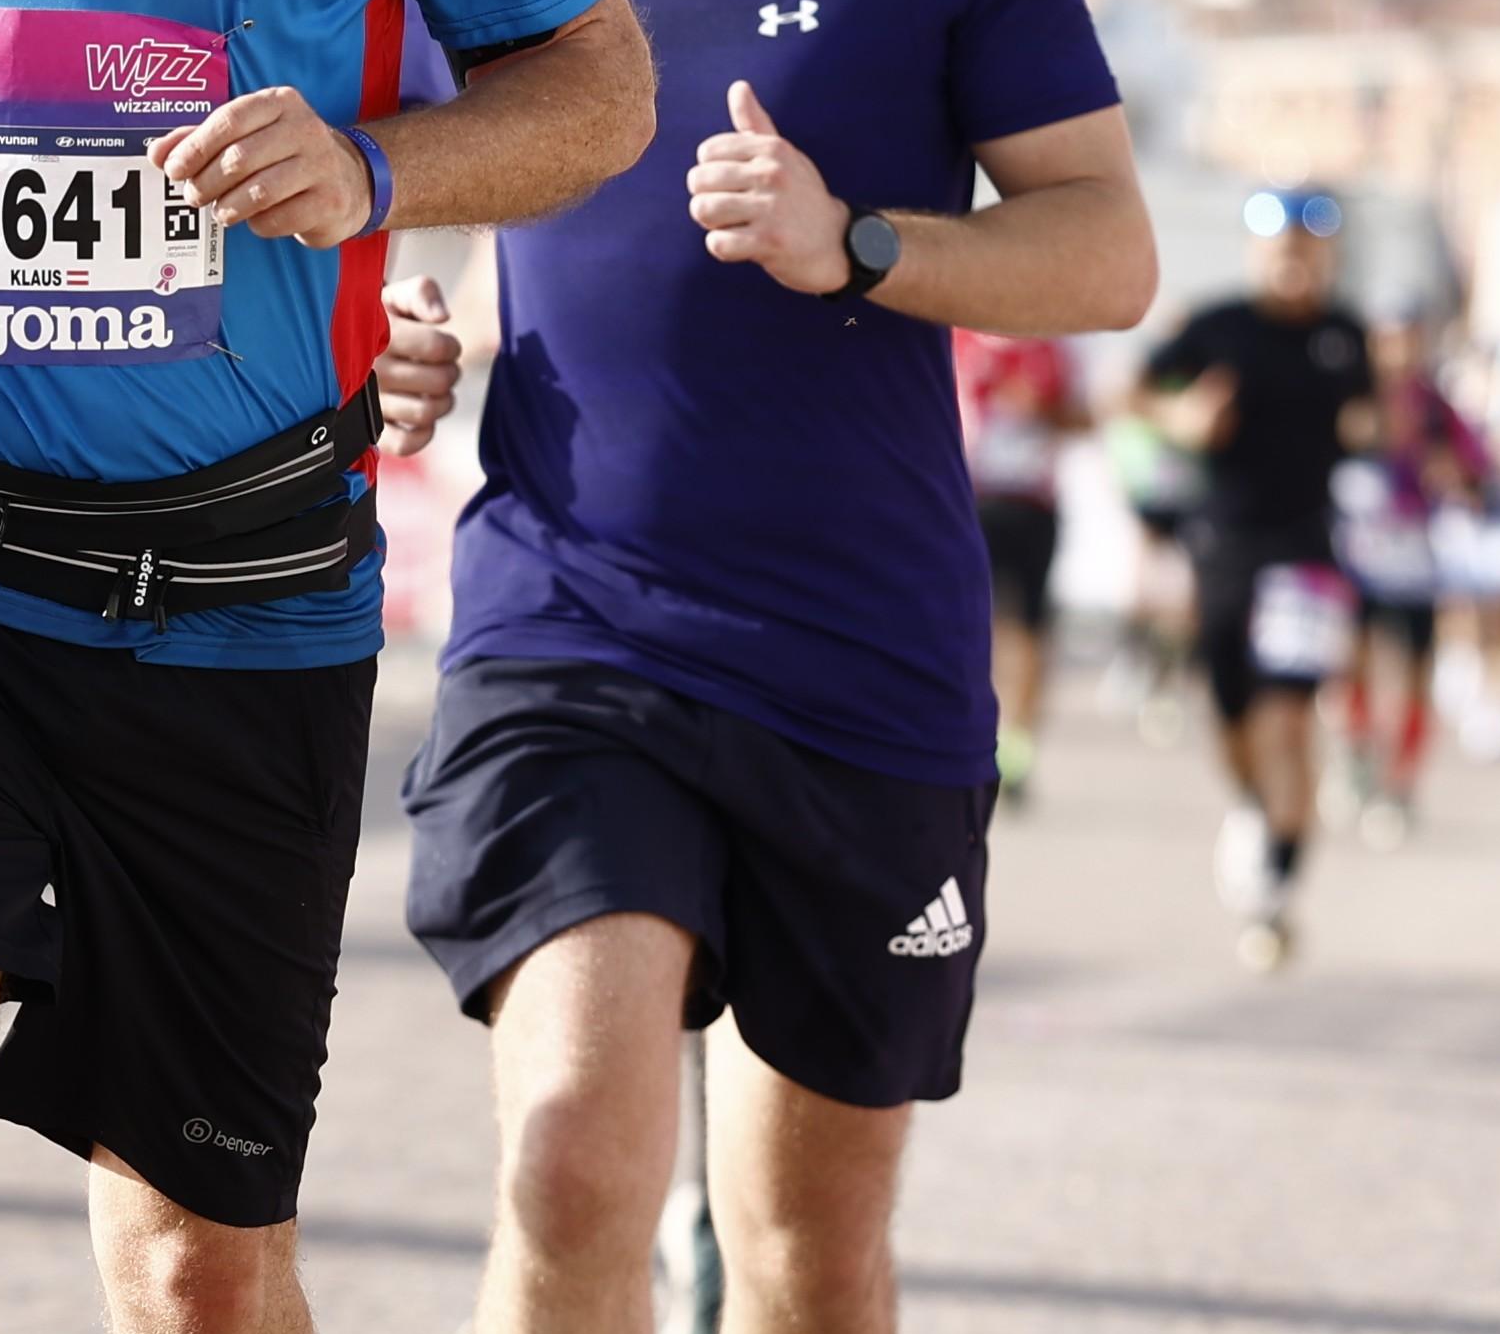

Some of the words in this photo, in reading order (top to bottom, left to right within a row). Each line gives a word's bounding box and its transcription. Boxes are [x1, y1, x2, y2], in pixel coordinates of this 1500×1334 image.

[113, 98, 211, 113] wizzair.com
[76, 138, 125, 147] HYUNDAI
[209, 240, 218, 263] CHECK
[10, 269, 63, 286] KLAUS
[207, 269, 219, 277] 4
[134, 548, 154, 607] CÖCITO
[887, 924, 973, 958] adidas
[213, 1129, 274, 1157] benger
